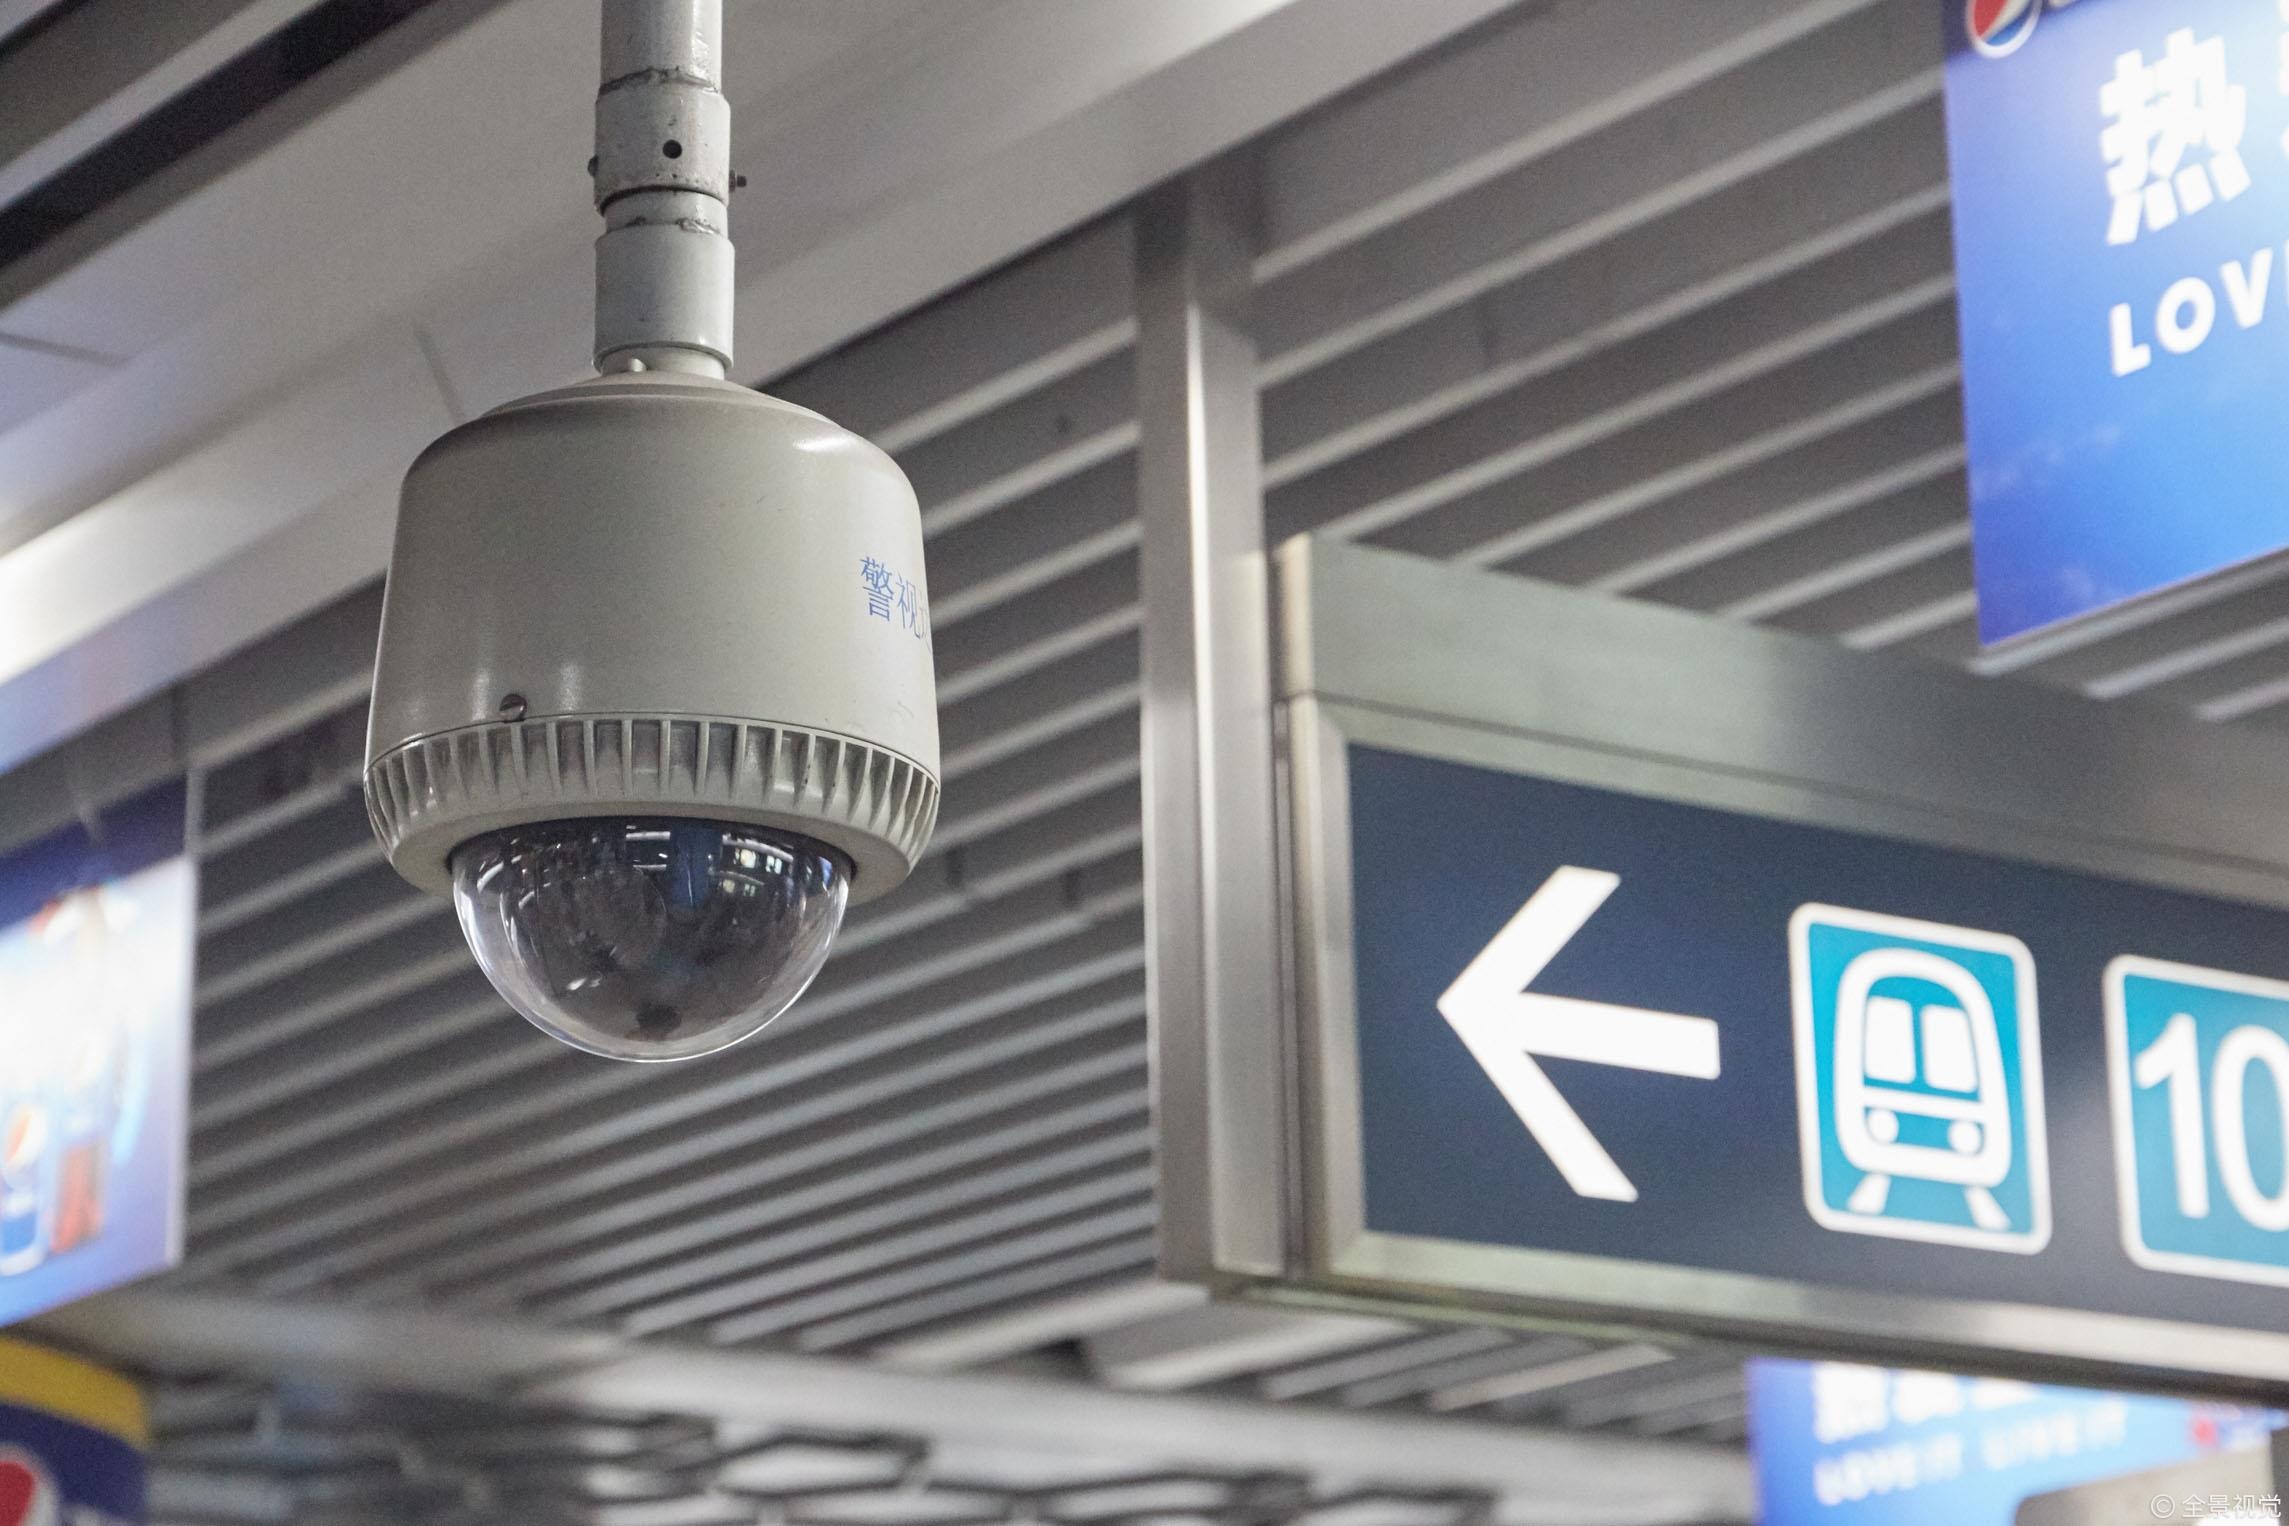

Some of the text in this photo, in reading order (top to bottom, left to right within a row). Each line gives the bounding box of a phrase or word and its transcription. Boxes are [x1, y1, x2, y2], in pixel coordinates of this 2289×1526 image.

[2100, 0, 2289, 246] 热
[2109, 238, 2289, 377] LOV
[859, 556, 932, 652] 警视
[2135, 1012, 2289, 1232] 10
